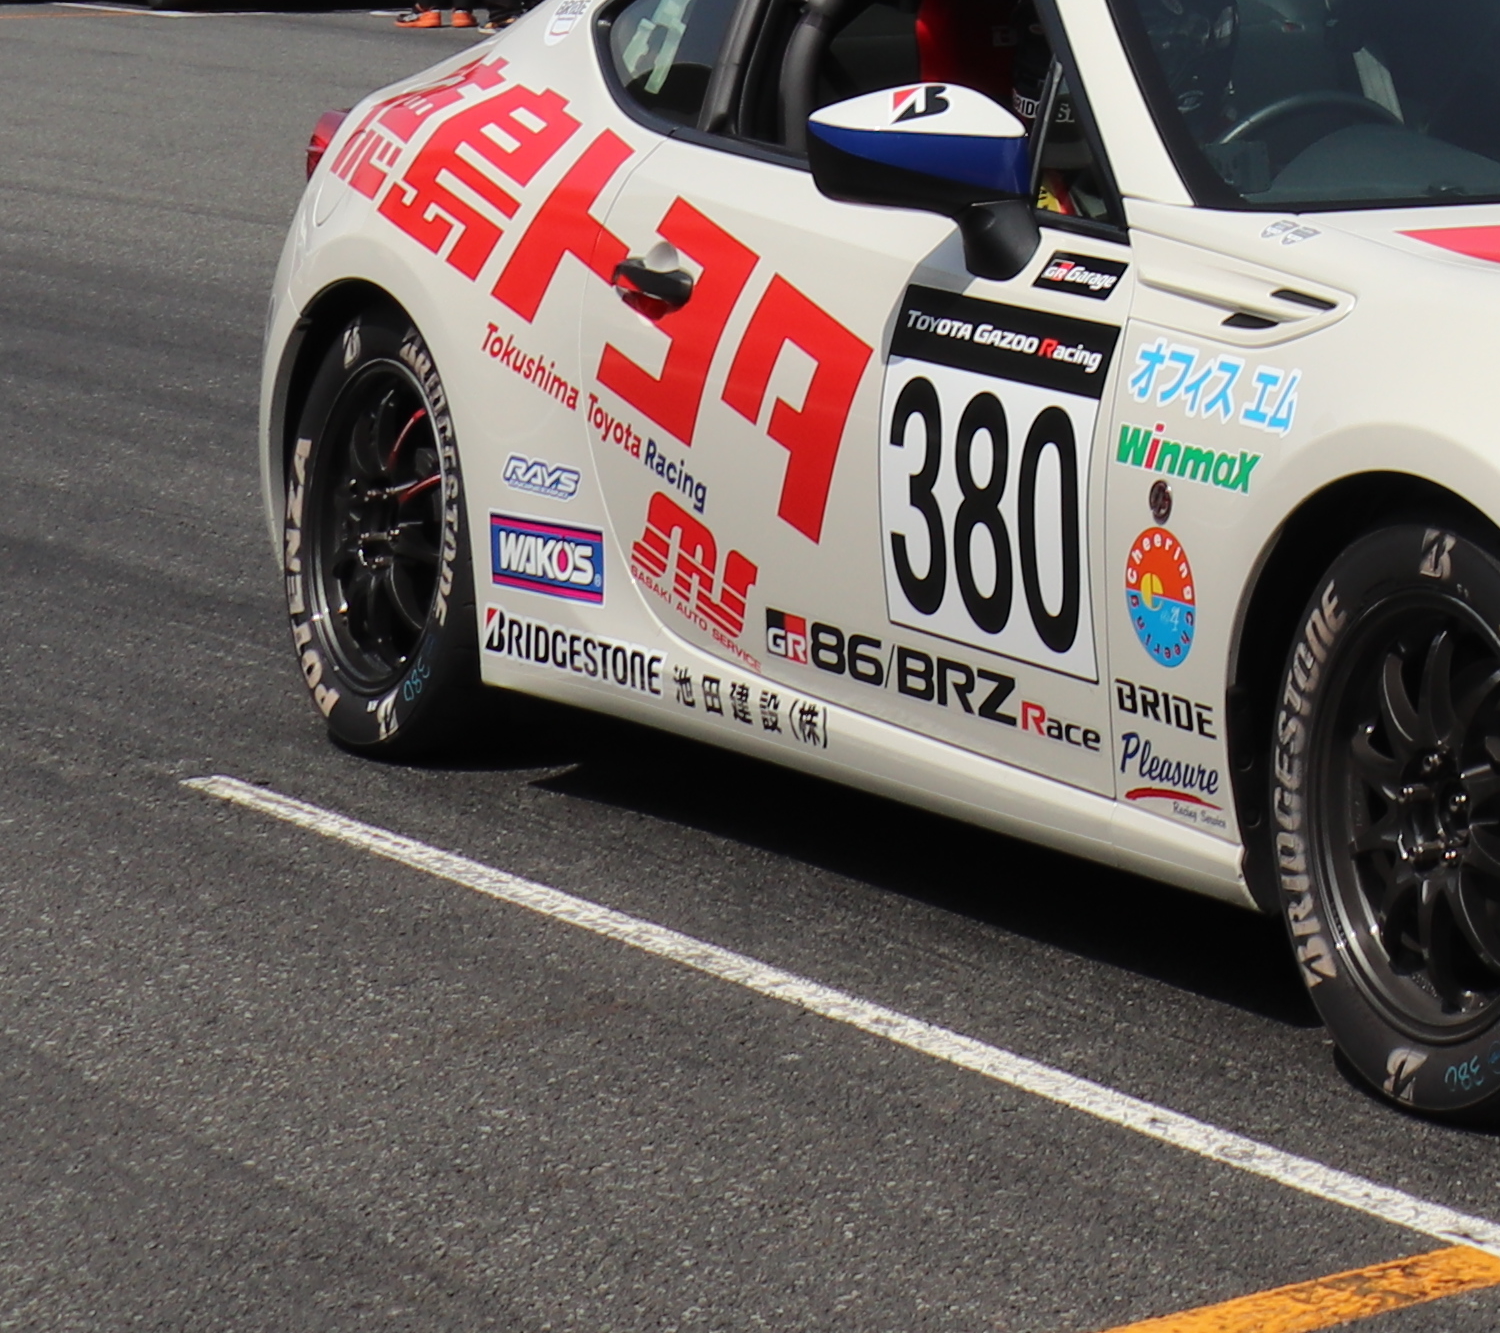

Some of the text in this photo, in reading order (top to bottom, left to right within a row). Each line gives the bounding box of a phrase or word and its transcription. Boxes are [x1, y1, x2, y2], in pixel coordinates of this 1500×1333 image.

[1044, 263, 1117, 290] GR Garage
[907, 310, 1101, 374] TOYOTA GAZOO Racing
[480, 322, 708, 513] Tokushima Toyota Racing
[1130, 342, 1298, 434] オフィス エム
[504, 455, 580, 495] RAYS
[890, 376, 1080, 654] 380
[1127, 533, 1193, 600] Cheering
[485, 608, 661, 696] BRIDGESTONE
[630, 565, 762, 673] SASAKI AUTO SERVICE
[767, 623, 1100, 751] GR 86/BRZ Race
[1114, 679, 1217, 740] BRIDE
[1120, 732, 1219, 795] Pleasure
[1171, 801, 1198, 823] Racing
